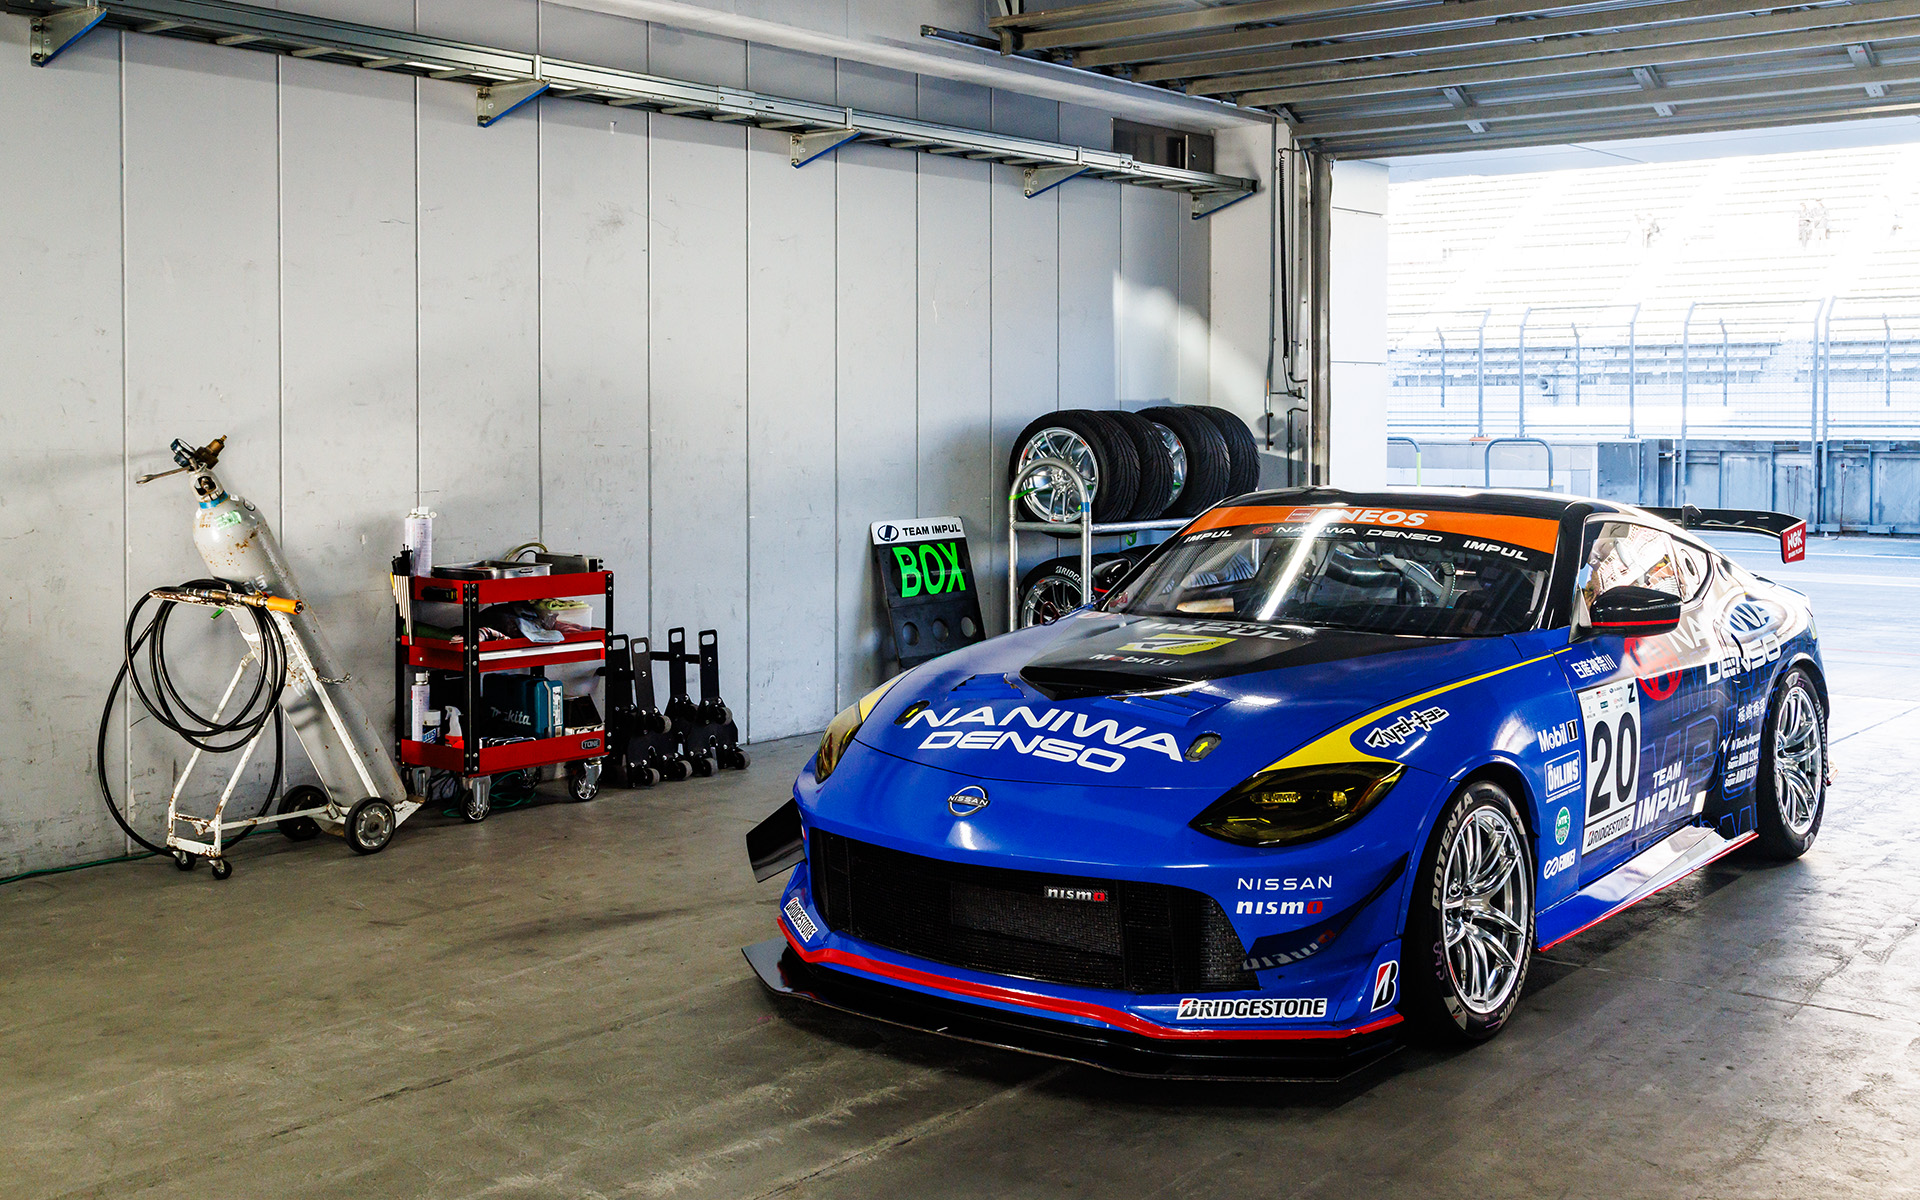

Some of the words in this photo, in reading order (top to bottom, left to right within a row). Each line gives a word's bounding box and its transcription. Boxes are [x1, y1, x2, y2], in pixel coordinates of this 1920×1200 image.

[902, 527, 930, 537] TEAM
[931, 523, 961, 534] IMPUL
[1183, 529, 1233, 544] IMPUL
[1276, 525, 1357, 535] NAIWA
[1364, 528, 1444, 543] DENSO
[1787, 528, 1803, 552] NGK
[1463, 540, 1530, 561] IMPUL
[892, 542, 966, 598] BOX
[1141, 622, 1291, 641] IMPUL
[1195, 620, 1271, 630] TEAM
[1089, 653, 1154, 664] Mobil
[1570, 653, 1618, 679] 日産神奈川
[490, 706, 532, 726] mkita
[1367, 706, 1448, 746] マツモトキヨシ
[903, 705, 1185, 763] NANIWA
[1536, 723, 1569, 753] Mobil
[917, 730, 1127, 773] DENSO
[1547, 760, 1580, 792] ÖHLINS
[1588, 711, 1638, 818] 20
[1652, 760, 1683, 789] TEAM
[947, 795, 989, 806] NISSAN
[1635, 777, 1692, 831] IMPUL
[1586, 813, 1632, 848] BRIDGESTONE
[1431, 792, 1474, 910] POTENZA
[1046, 887, 1106, 902] nismo
[1236, 875, 1333, 892] NISSAN
[785, 897, 817, 941] BRIDGESTONE
[1236, 900, 1324, 915] nismo
[1178, 998, 1328, 1018] BRIDGESTONE
